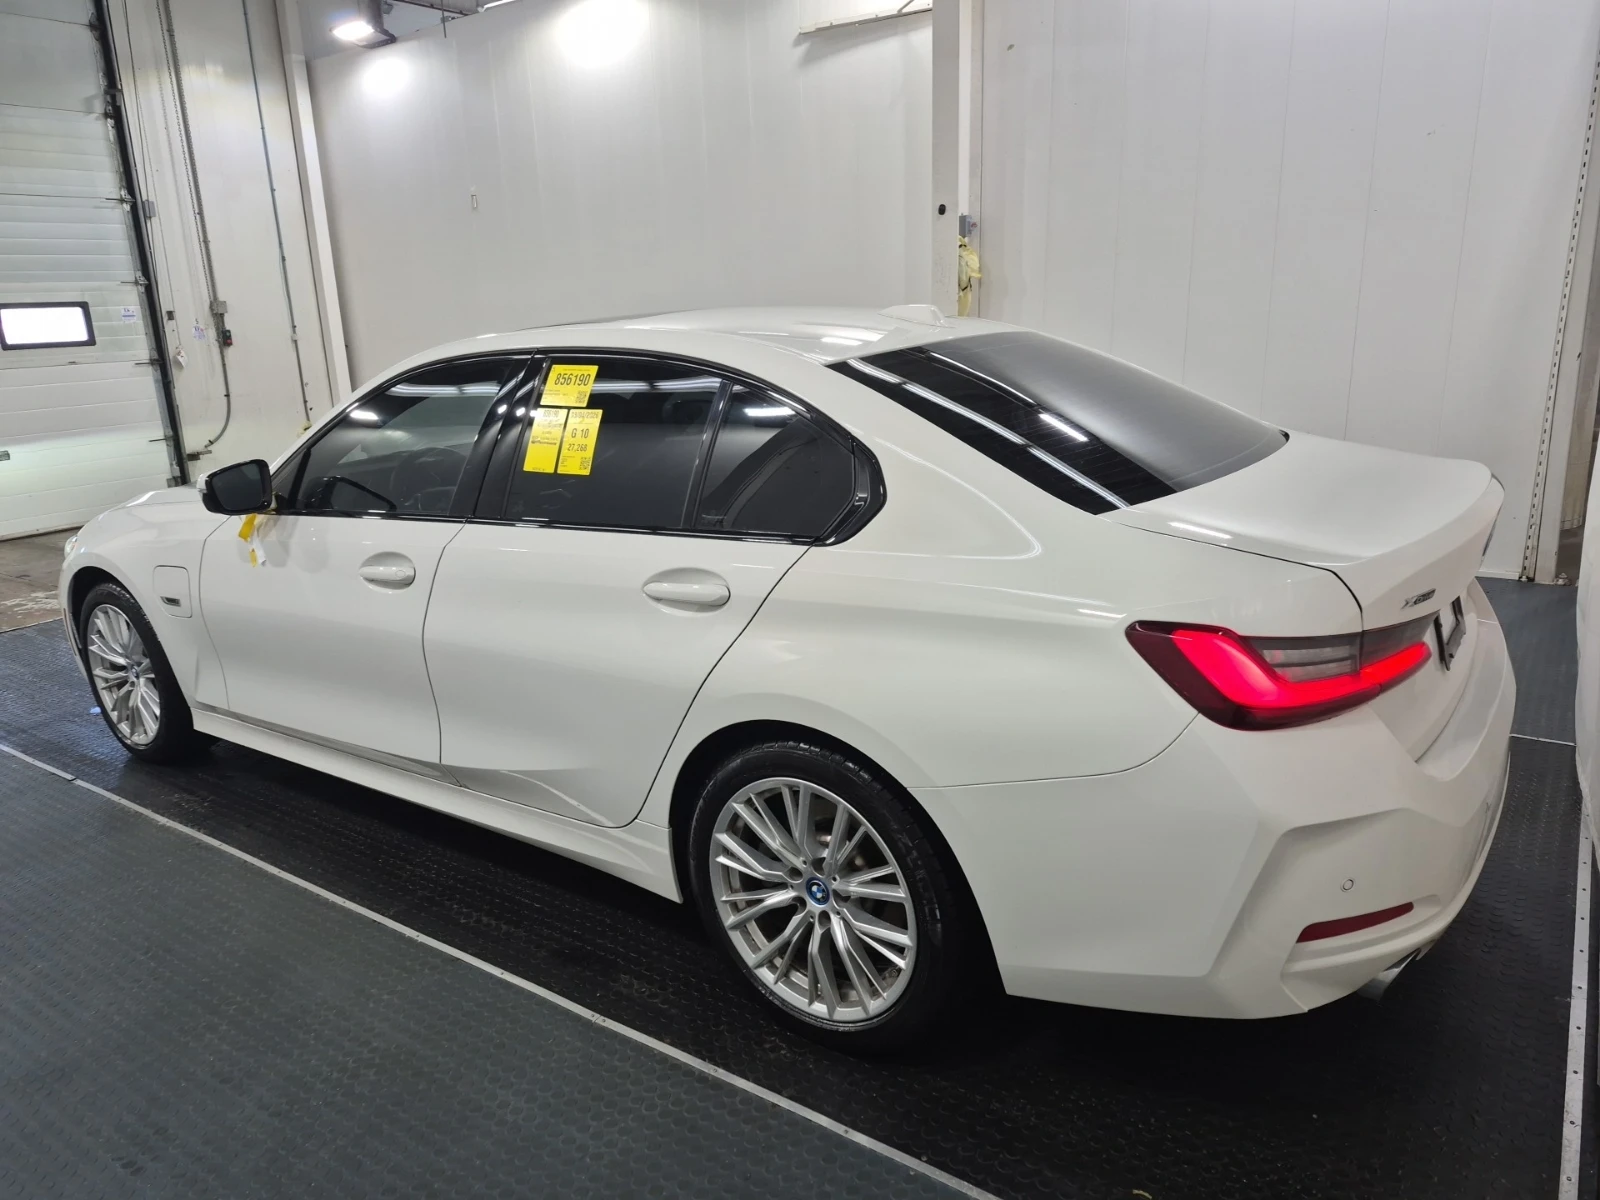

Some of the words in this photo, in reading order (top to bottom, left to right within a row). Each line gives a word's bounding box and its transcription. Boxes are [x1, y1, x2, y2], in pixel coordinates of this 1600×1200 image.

[554, 373, 591, 386] 856190
[571, 428, 578, 439] G
[580, 428, 590, 439] 10
